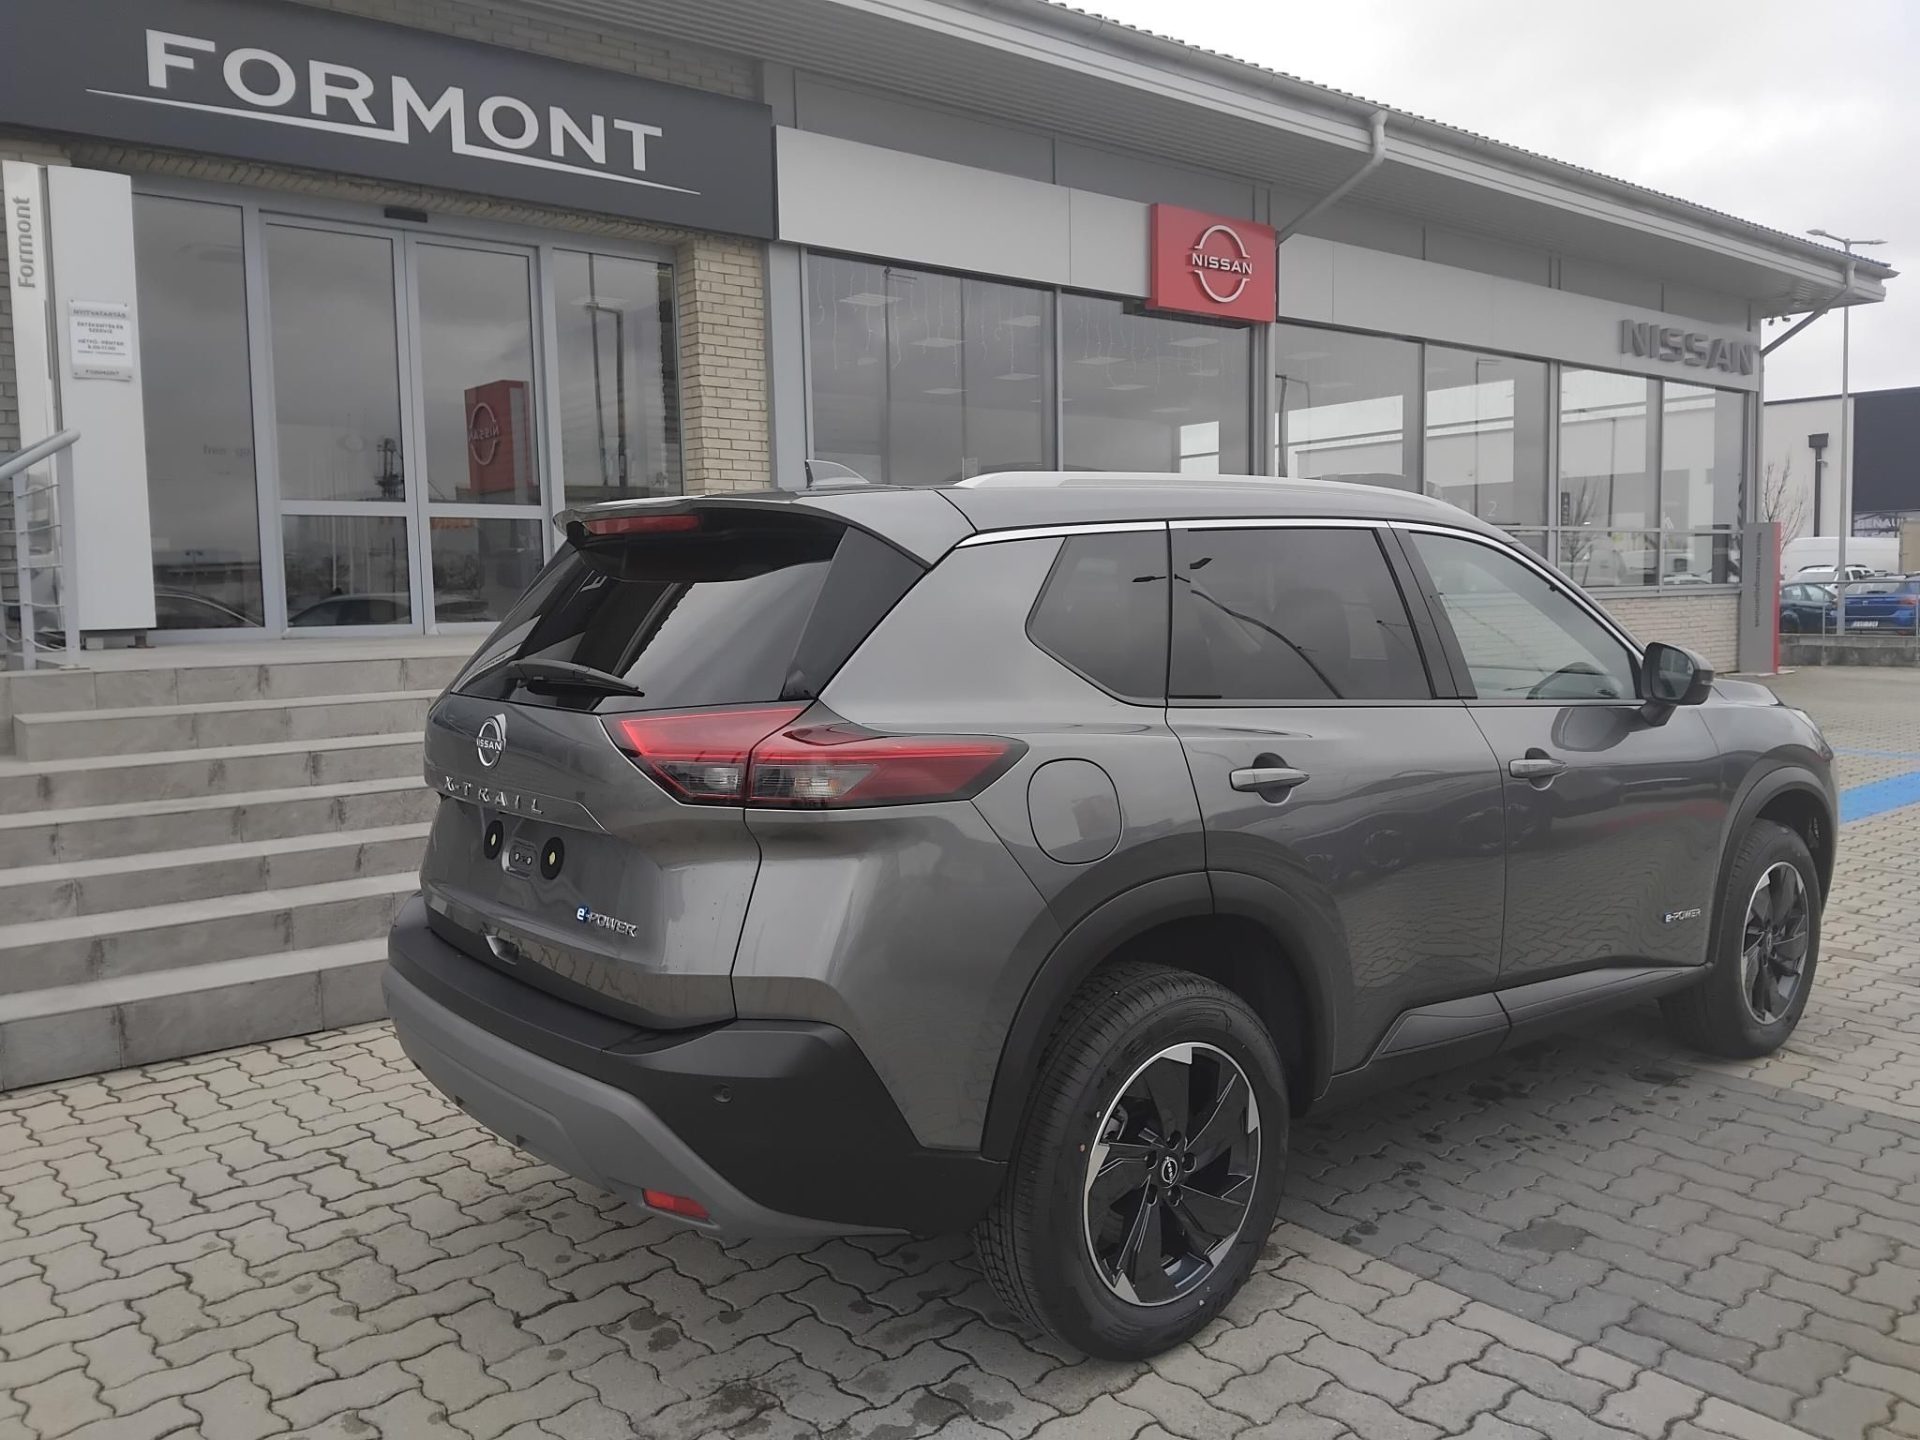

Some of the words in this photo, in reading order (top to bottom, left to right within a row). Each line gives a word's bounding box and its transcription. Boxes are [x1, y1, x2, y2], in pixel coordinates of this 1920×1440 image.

[146, 29, 662, 171] FORMONT
[13, 196, 36, 288] Formont
[1192, 253, 1253, 274] NISSAN
[1619, 319, 1758, 376] NISSAN
[445, 775, 544, 814] X-TRAIL
